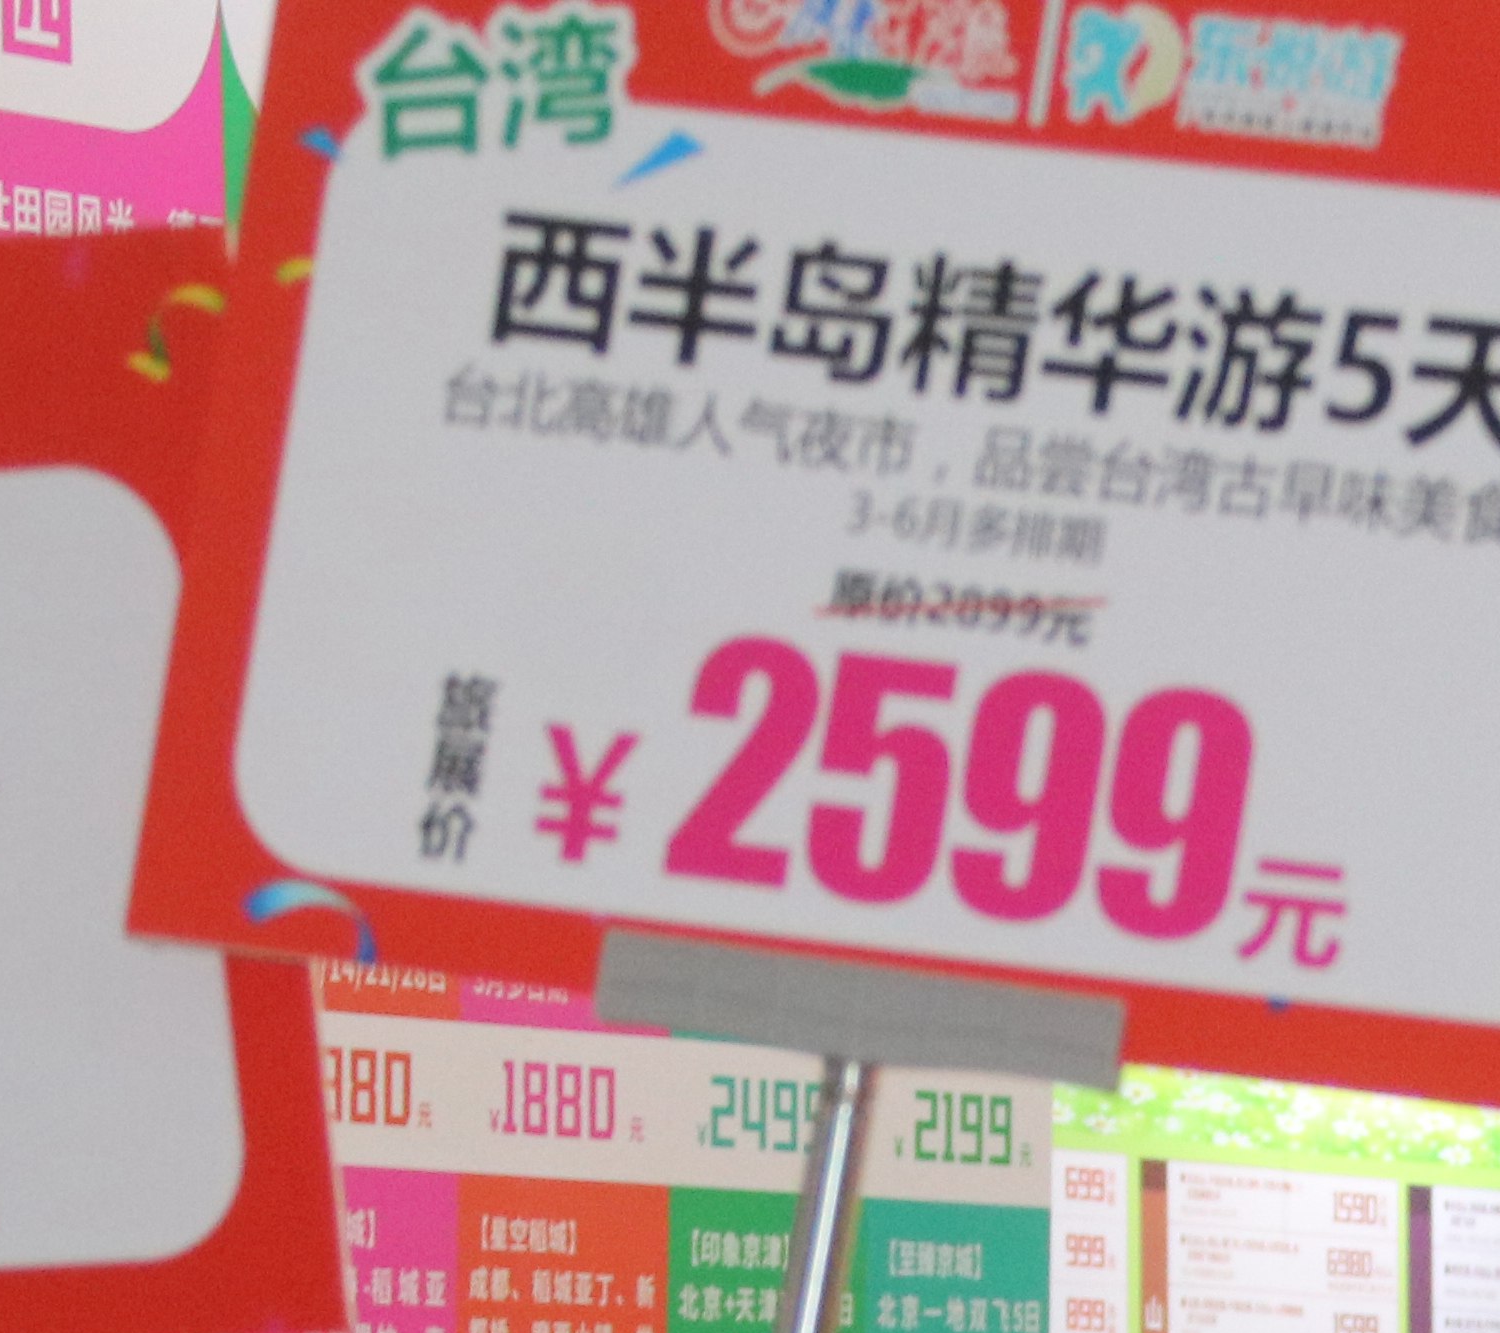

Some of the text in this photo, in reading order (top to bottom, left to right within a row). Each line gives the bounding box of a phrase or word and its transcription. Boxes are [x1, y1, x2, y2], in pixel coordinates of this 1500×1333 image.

[372, 14, 618, 158] 台湾
[419, 672, 499, 864] 旅展价
